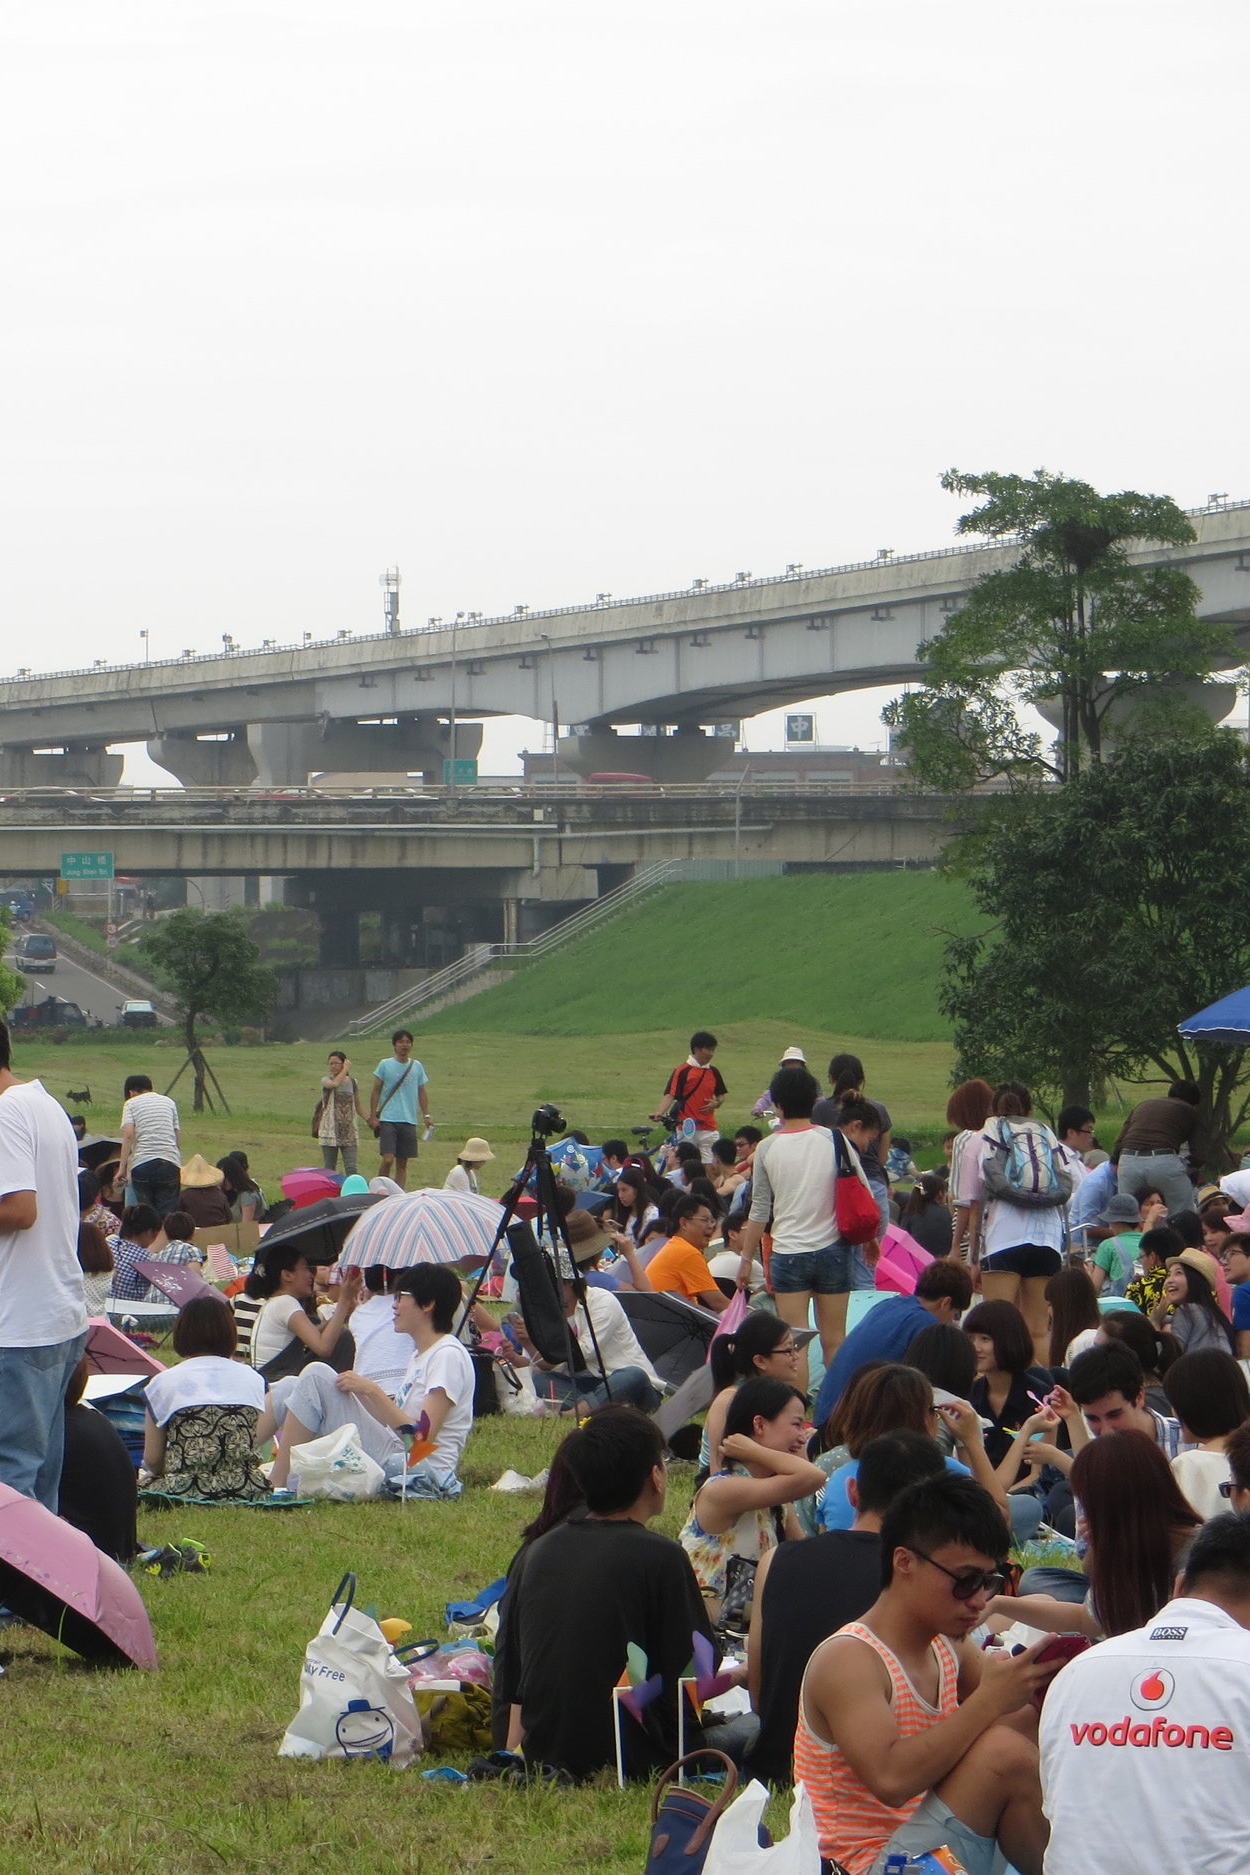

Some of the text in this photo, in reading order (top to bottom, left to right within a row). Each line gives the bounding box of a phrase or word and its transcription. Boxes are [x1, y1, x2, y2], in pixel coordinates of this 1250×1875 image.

[1153, 1627, 1186, 1637] BOSS
[318, 1665, 346, 1682] Free
[1070, 1715, 1235, 1751] vodafone
